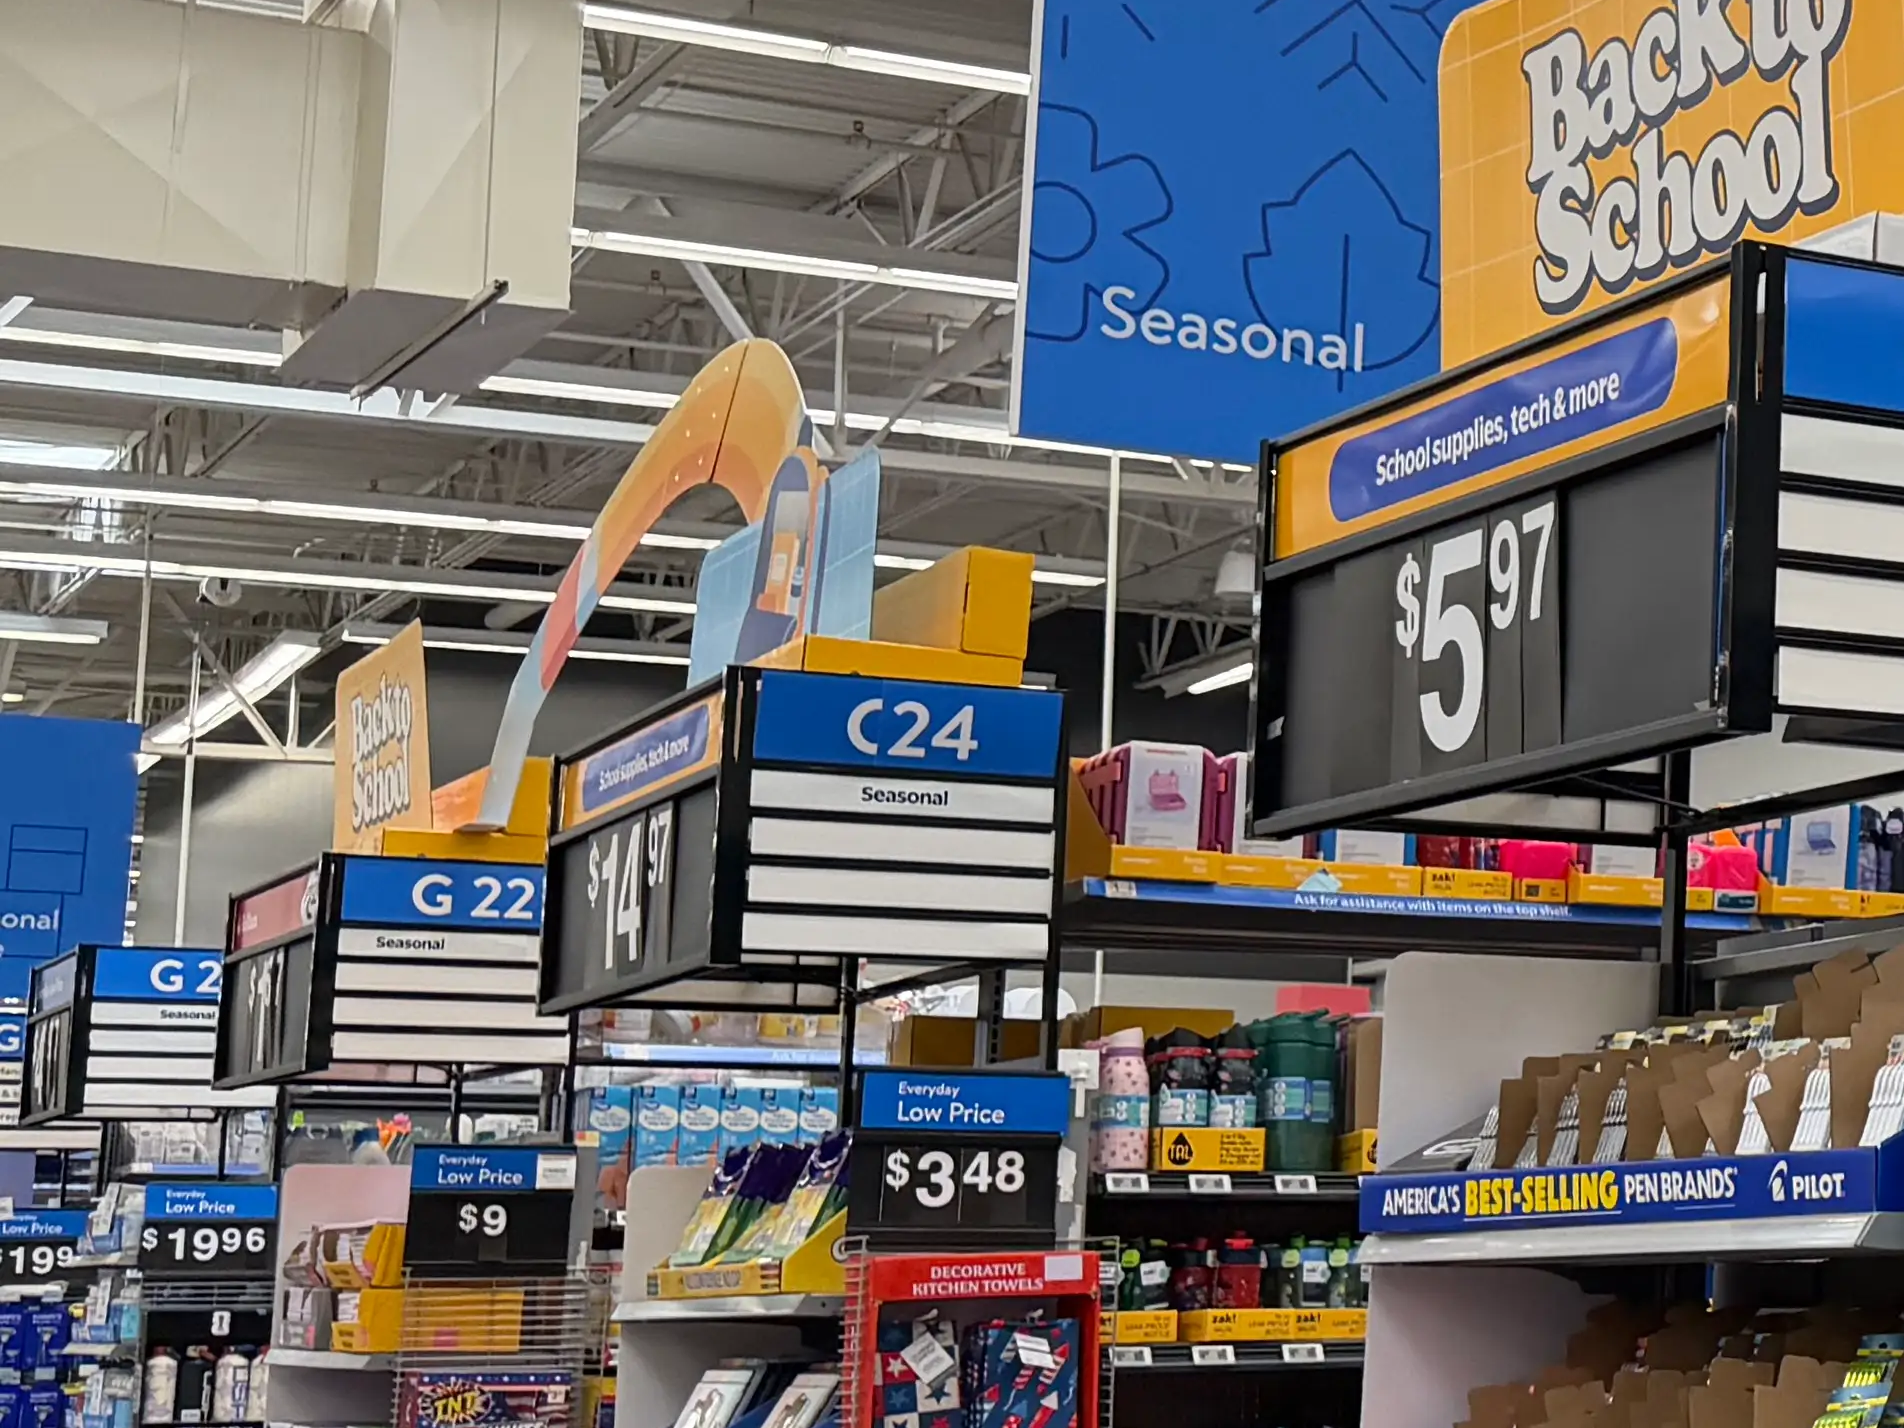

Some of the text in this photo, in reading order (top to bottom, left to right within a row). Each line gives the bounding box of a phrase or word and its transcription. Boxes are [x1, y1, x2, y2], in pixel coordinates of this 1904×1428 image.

[1530, 51, 1841, 318] School
[1100, 286, 1364, 374] Seasonal
[1376, 372, 1620, 486] School supplies, tech & more
[351, 676, 395, 763] Back
[846, 698, 979, 762] C24
[352, 733, 410, 832] School
[861, 786, 948, 807] Seasonal
[413, 874, 535, 919] G 22
[1, 910, 60, 930] onal
[376, 935, 445, 950] Seasonal
[149, 959, 222, 993] G 2
[160, 1009, 216, 1020] Seasonal
[898, 1082, 960, 1099] Everyday
[897, 1101, 1005, 1124] Low Price
[438, 1155, 487, 1167] Everyday
[437, 1169, 523, 1187] Low Price
[1792, 1172, 1844, 1200] PILOT
[166, 1189, 206, 1199] Everyday
[1382, 1180, 1460, 1217] AMERICA'S
[1464, 1170, 1618, 1215] BEST-SELLING
[1624, 1174, 1658, 1203] PEN
[165, 1199, 235, 1214] Low Price
[458, 1203, 508, 1236] $9
[930, 1263, 1026, 1281] DECORATIVE
[913, 1277, 1043, 1296] KITCHEN TOWELS
